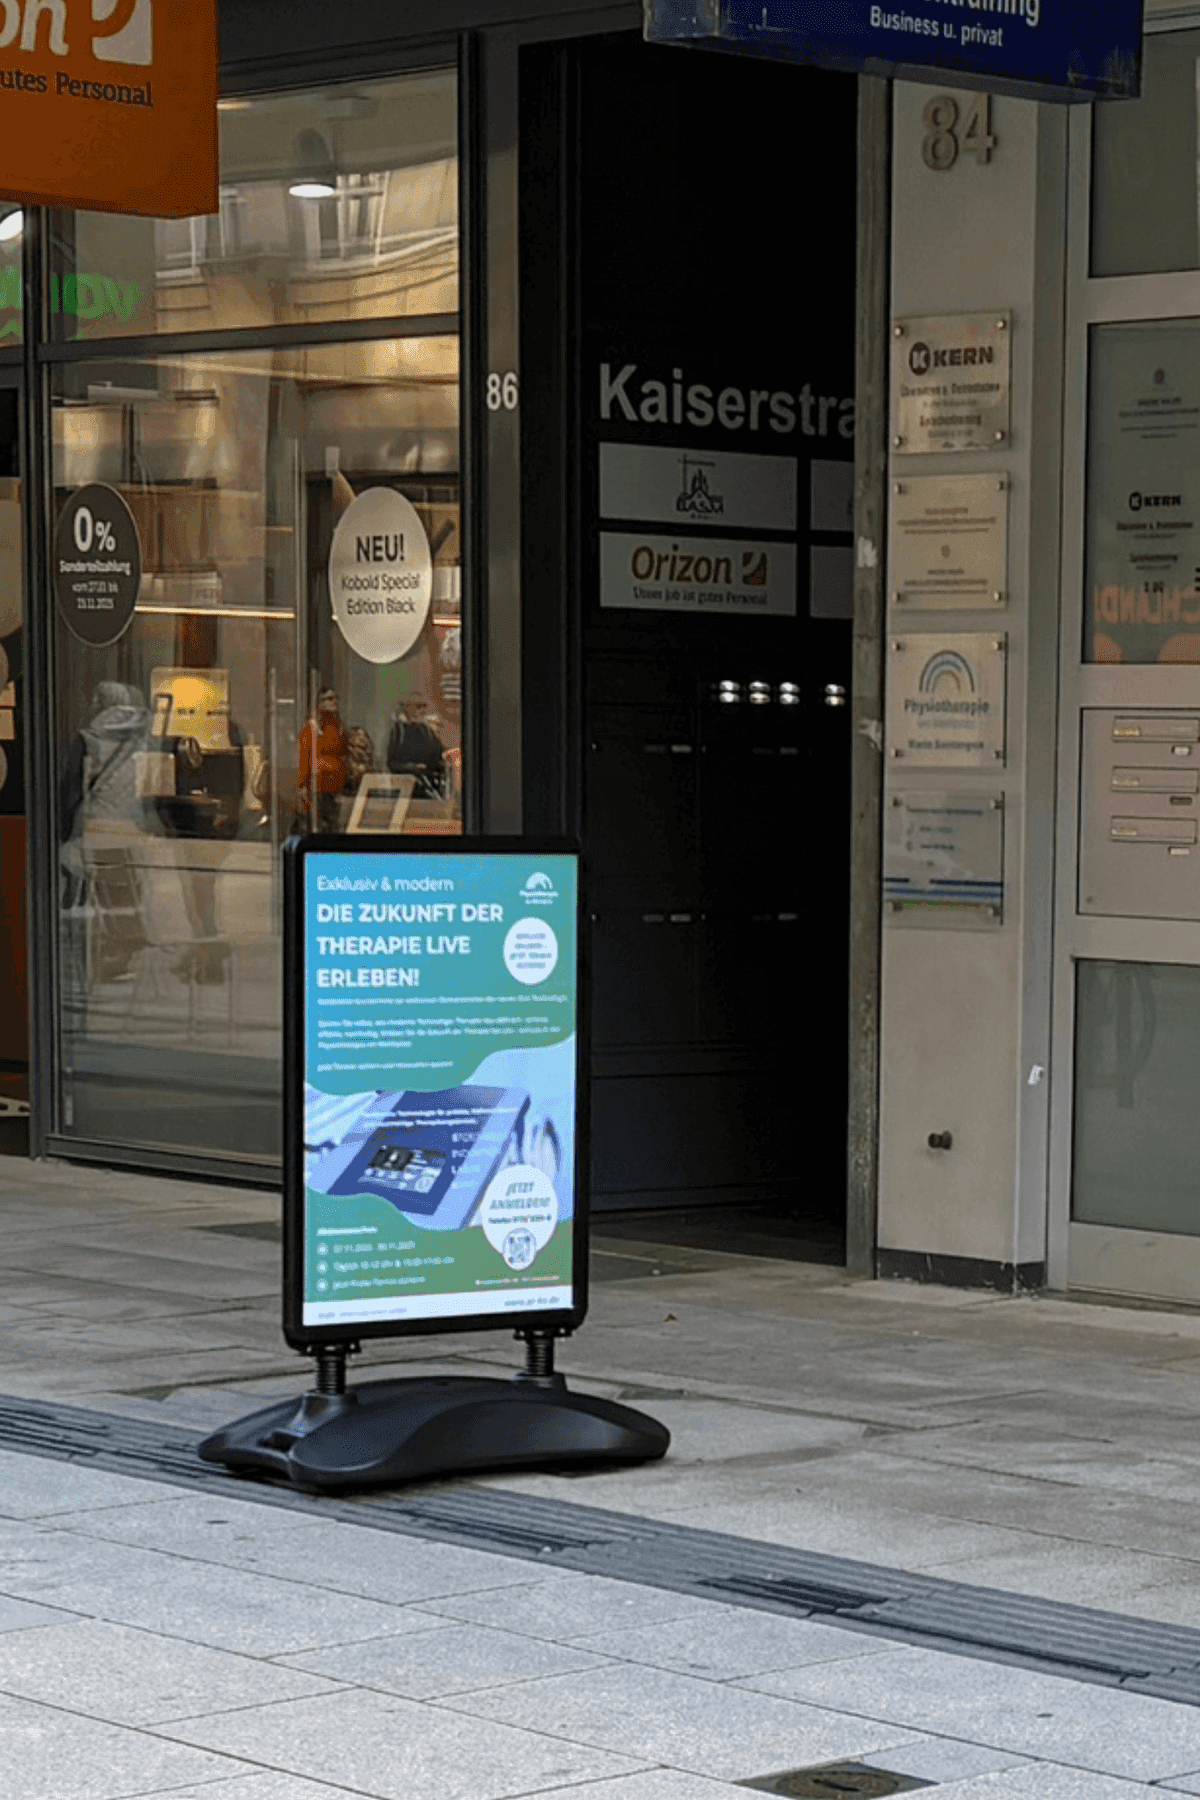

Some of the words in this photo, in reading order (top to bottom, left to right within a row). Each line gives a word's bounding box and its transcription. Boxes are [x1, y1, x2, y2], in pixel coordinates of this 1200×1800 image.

[870, 5, 939, 36] Business
[943, 22, 957, 39] u.
[961, 22, 1003, 47] privat
[56, 71, 153, 107] Personal
[921, 93, 998, 171] 84
[933, 346, 994, 368] KERN
[486, 373, 518, 410] 86
[600, 363, 856, 438] Kaiserstra
[356, 533, 404, 562] NEU!
[631, 543, 732, 585] Orizon
[341, 575, 379, 591] Kobold
[381, 573, 420, 593] Special
[347, 598, 383, 615] Edition
[386, 597, 416, 615] Black
[316, 874, 379, 891] Exklusiv
[380, 876, 392, 892] &
[394, 876, 454, 892] modern
[316, 903, 354, 923] DIE
[358, 903, 457, 923] ZUKUNFT
[460, 903, 504, 923] DER
[316, 935, 422, 956] THERAPIE
[426, 935, 471, 955] LIVE
[316, 967, 420, 988] ERLEBEN!
